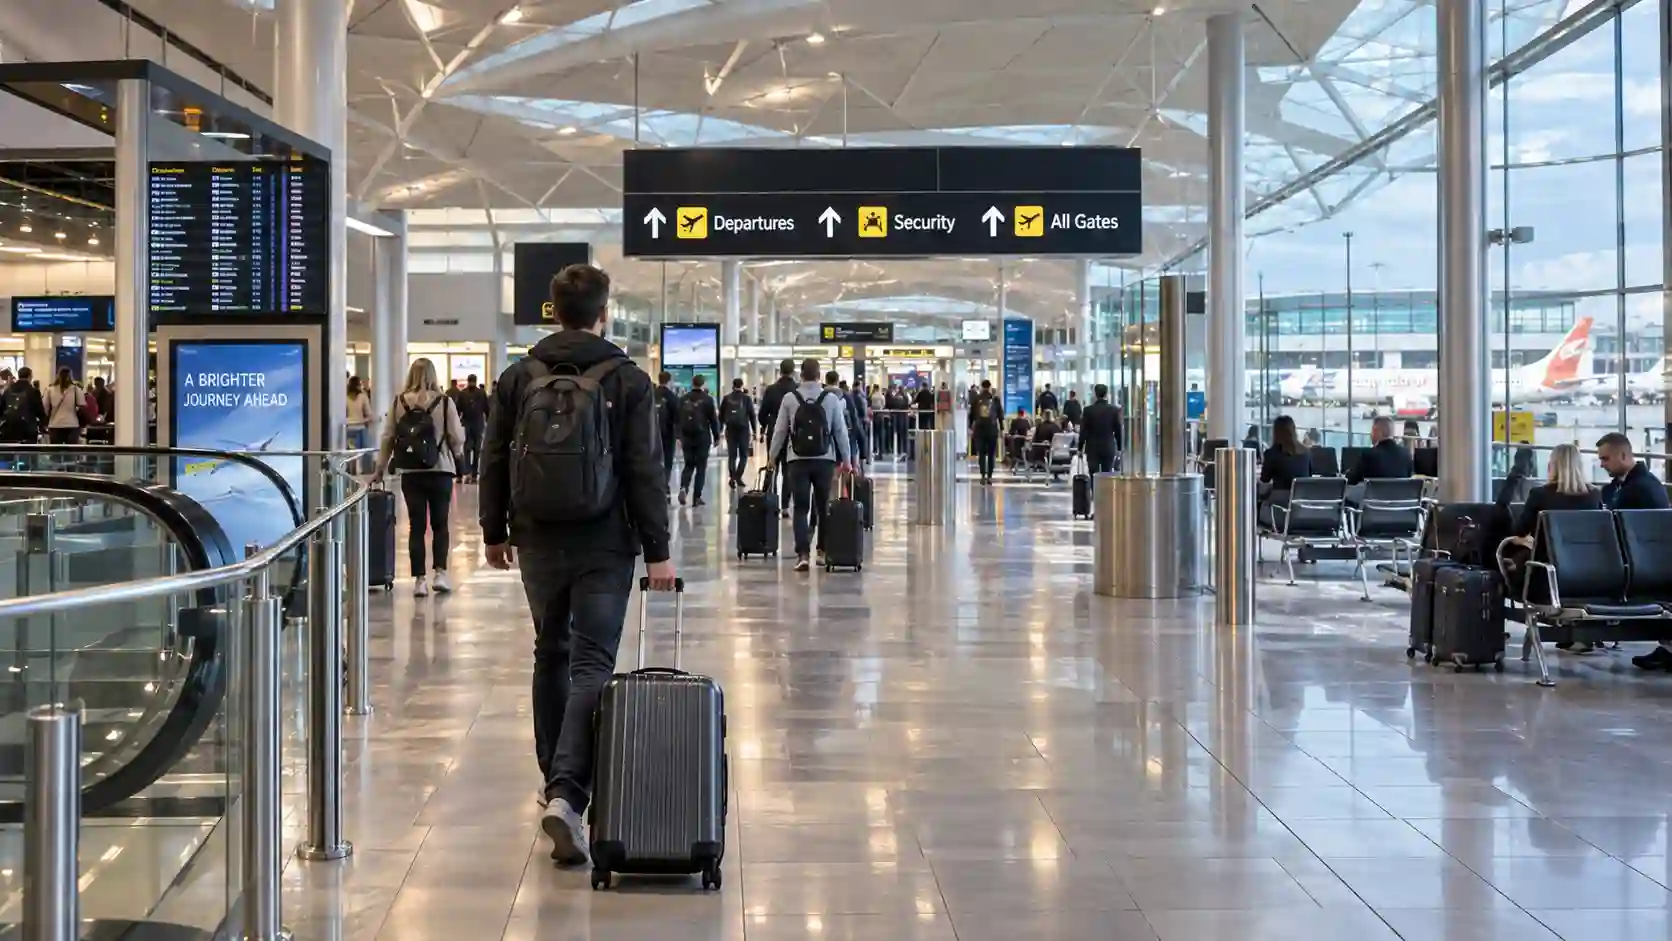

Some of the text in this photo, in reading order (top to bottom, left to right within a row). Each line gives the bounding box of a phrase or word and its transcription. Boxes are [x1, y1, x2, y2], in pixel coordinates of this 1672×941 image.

[714, 215, 795, 234] Departures
[894, 213, 956, 234] Security
[1050, 213, 1119, 230] All Gates
[184, 373, 266, 388] A BRIGHTER
[183, 392, 288, 407] JOURNEY AHEAD
